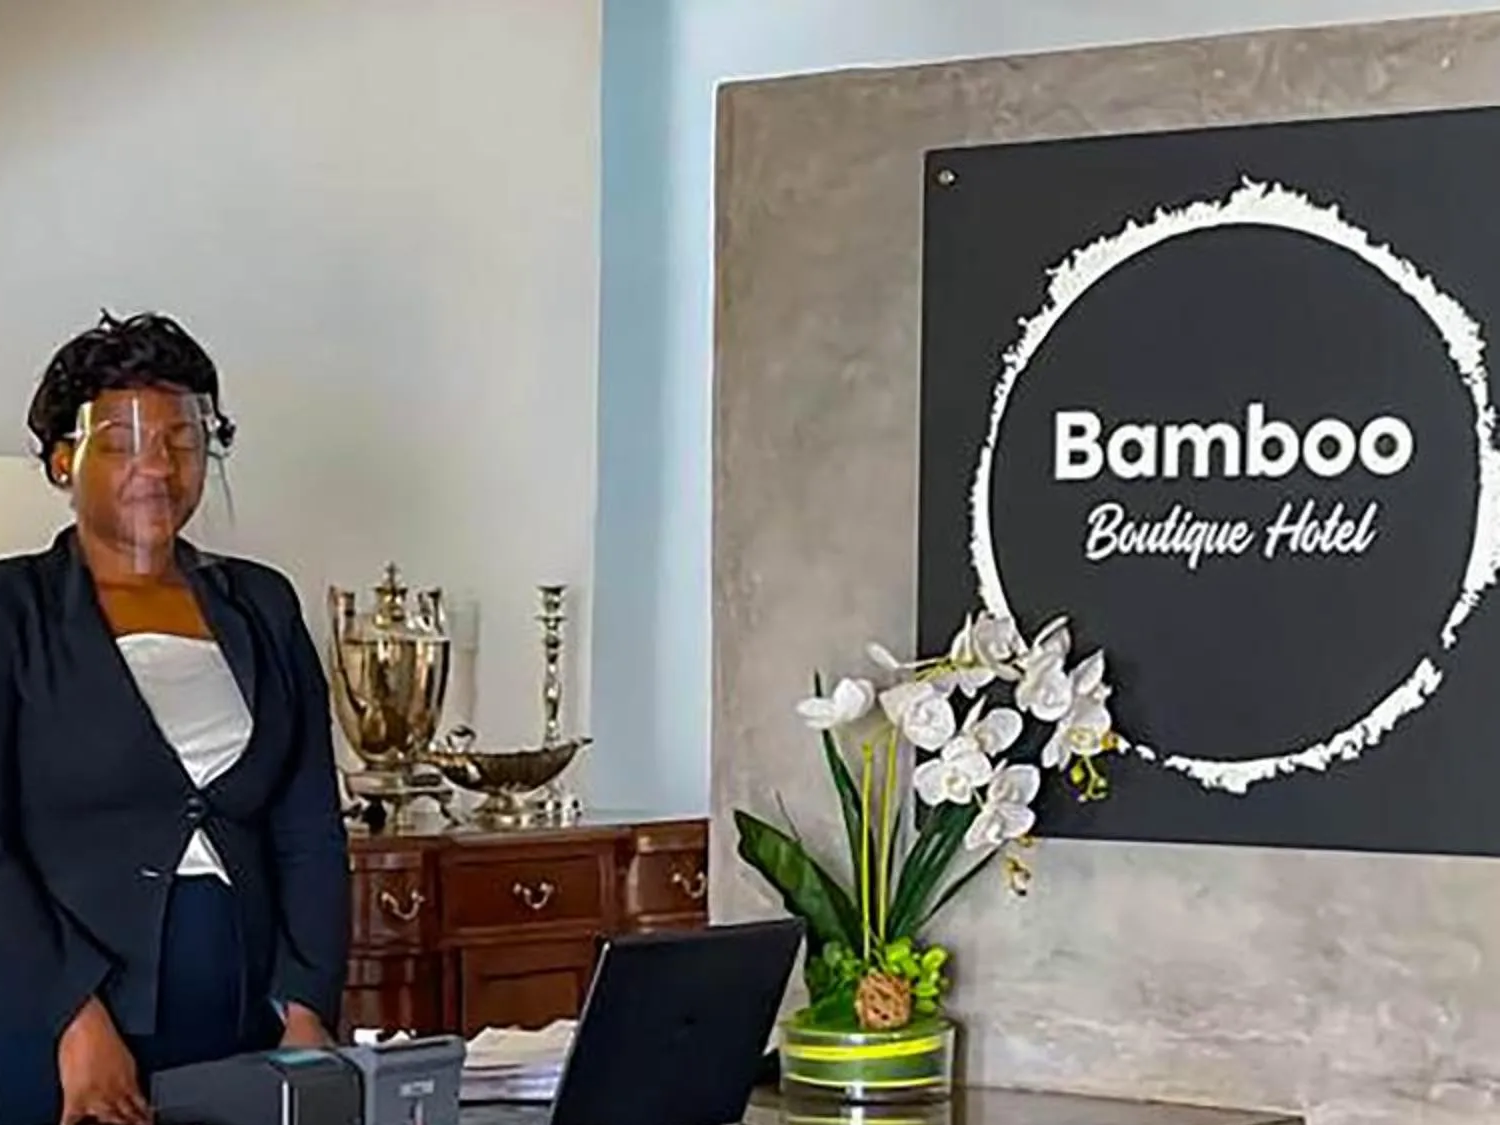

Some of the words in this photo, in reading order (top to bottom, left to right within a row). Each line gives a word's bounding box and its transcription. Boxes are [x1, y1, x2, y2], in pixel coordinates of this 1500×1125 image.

[1055, 403, 1413, 480] Bamboo
[1086, 503, 1254, 569] Boutique
[1264, 499, 1377, 558] Hotel
